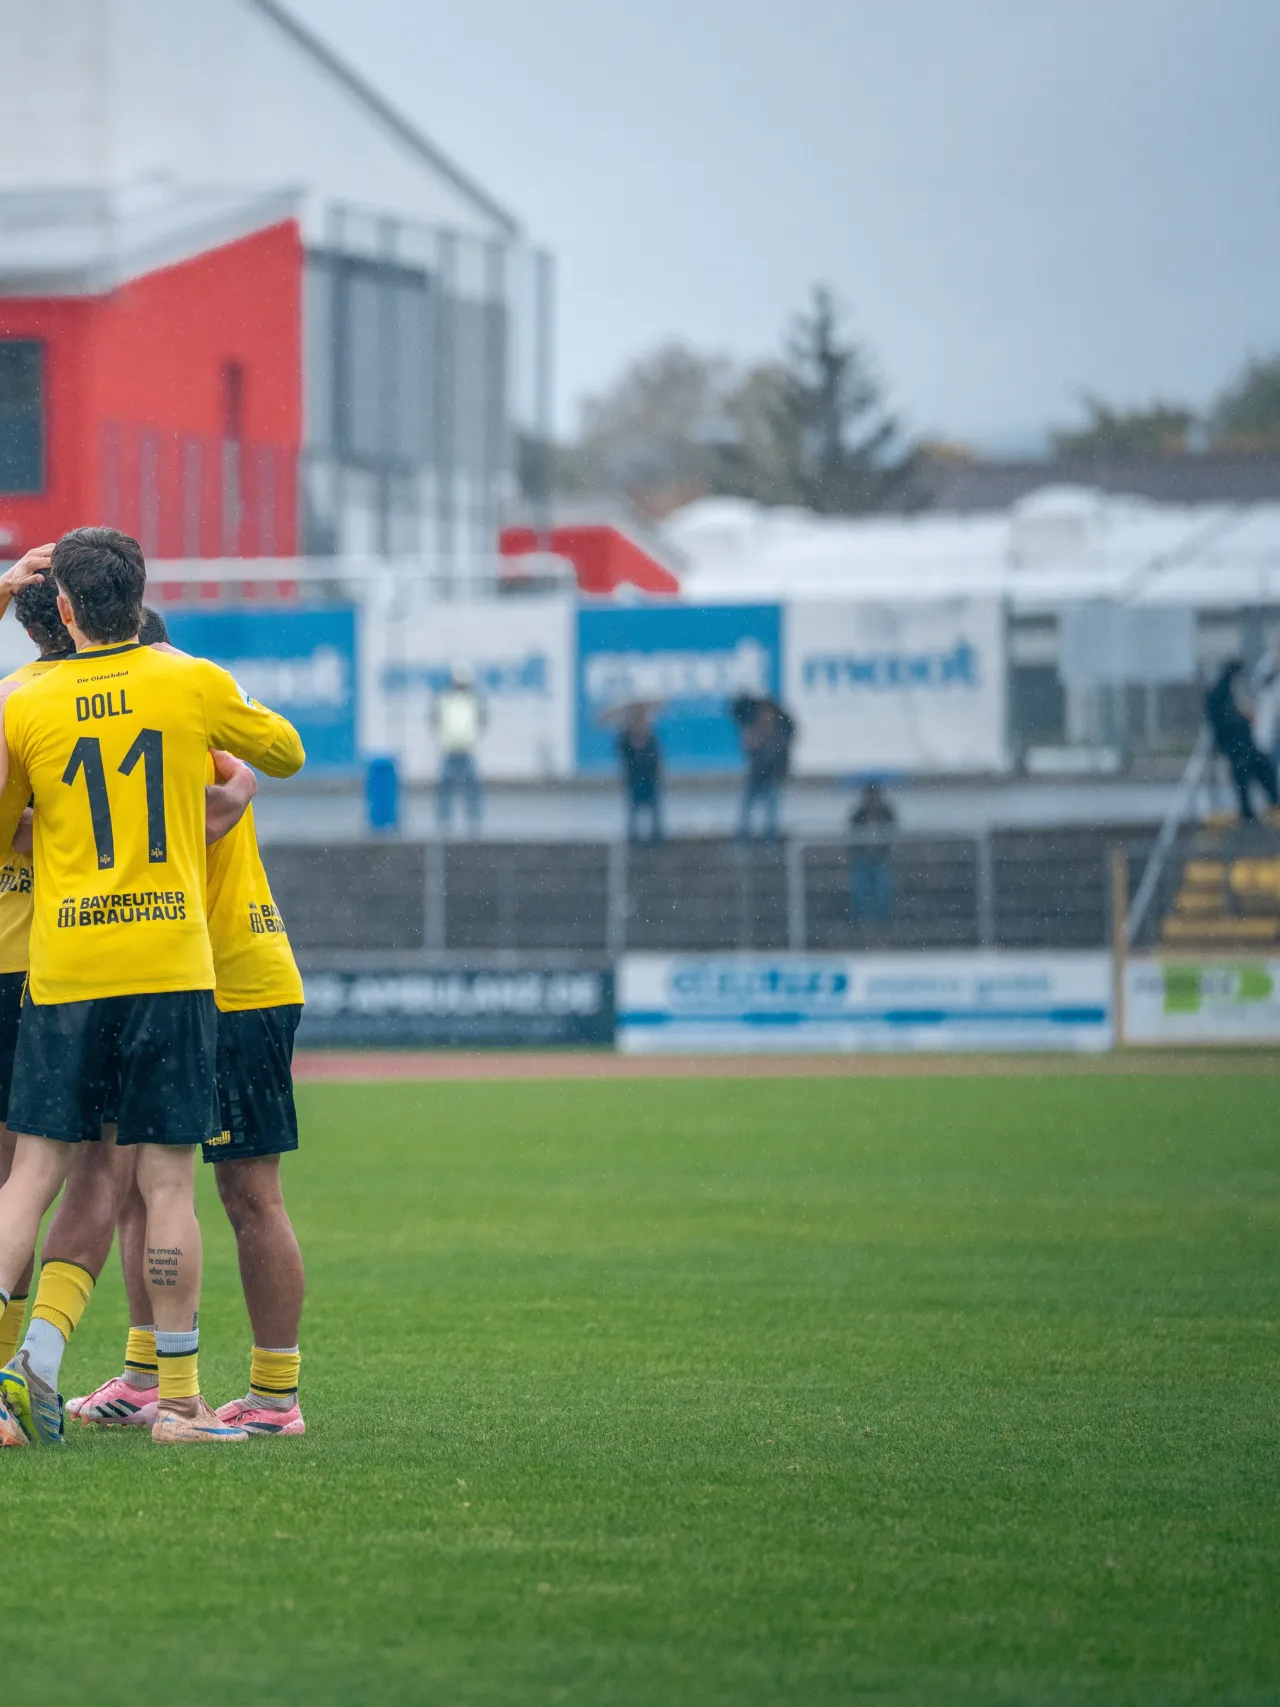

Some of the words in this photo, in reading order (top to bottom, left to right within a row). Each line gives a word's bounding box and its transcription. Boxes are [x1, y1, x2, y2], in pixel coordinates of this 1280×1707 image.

[91, 670, 130, 682] Oldschdod
[76, 689, 133, 722] DOLL
[61, 728, 167, 870] 11
[79, 891, 186, 909] BAYREUTHER
[78, 905, 187, 926] BRAUHAUS
[165, 1269, 178, 1277] you
